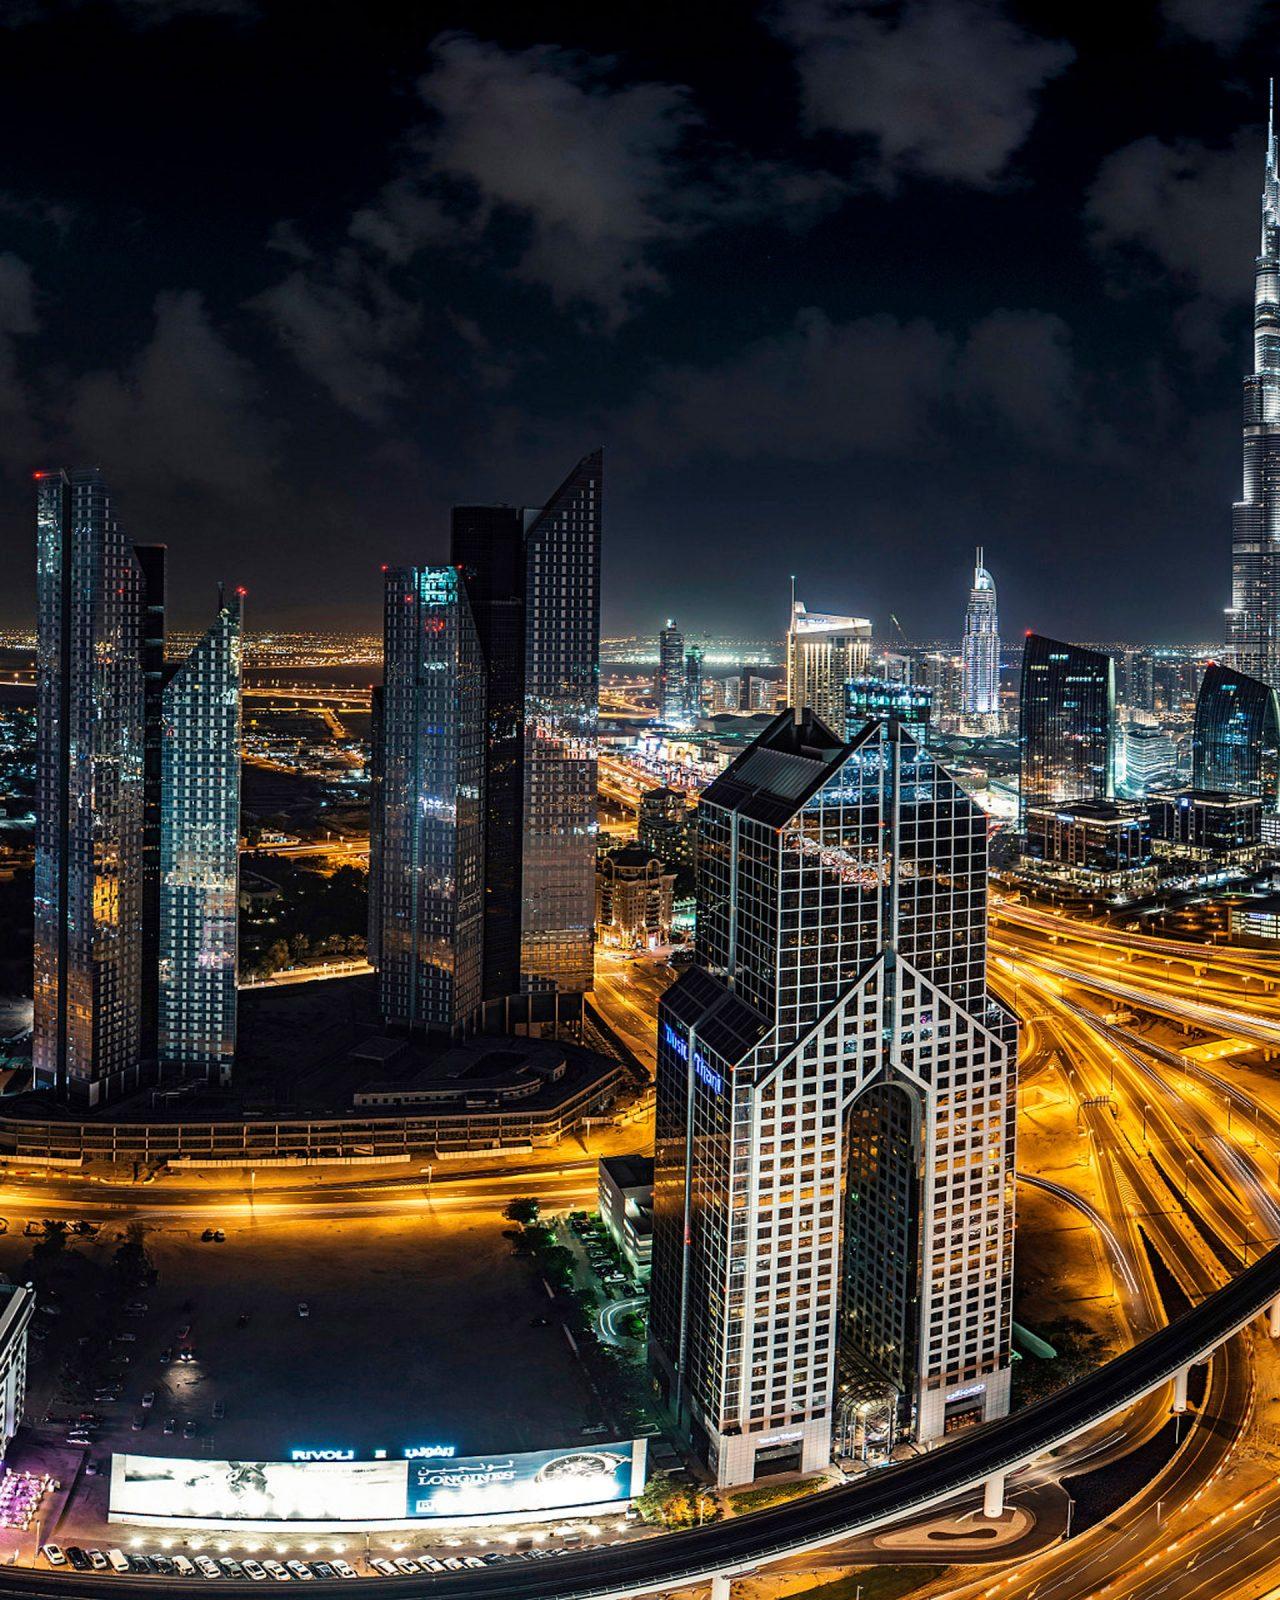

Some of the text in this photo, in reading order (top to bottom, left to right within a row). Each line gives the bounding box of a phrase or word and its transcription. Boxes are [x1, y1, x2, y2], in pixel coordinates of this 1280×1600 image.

[693, 1052, 721, 1095] Thani
[291, 1449, 355, 1461] RIVOLI
[417, 1470, 517, 1488] LONGINES
